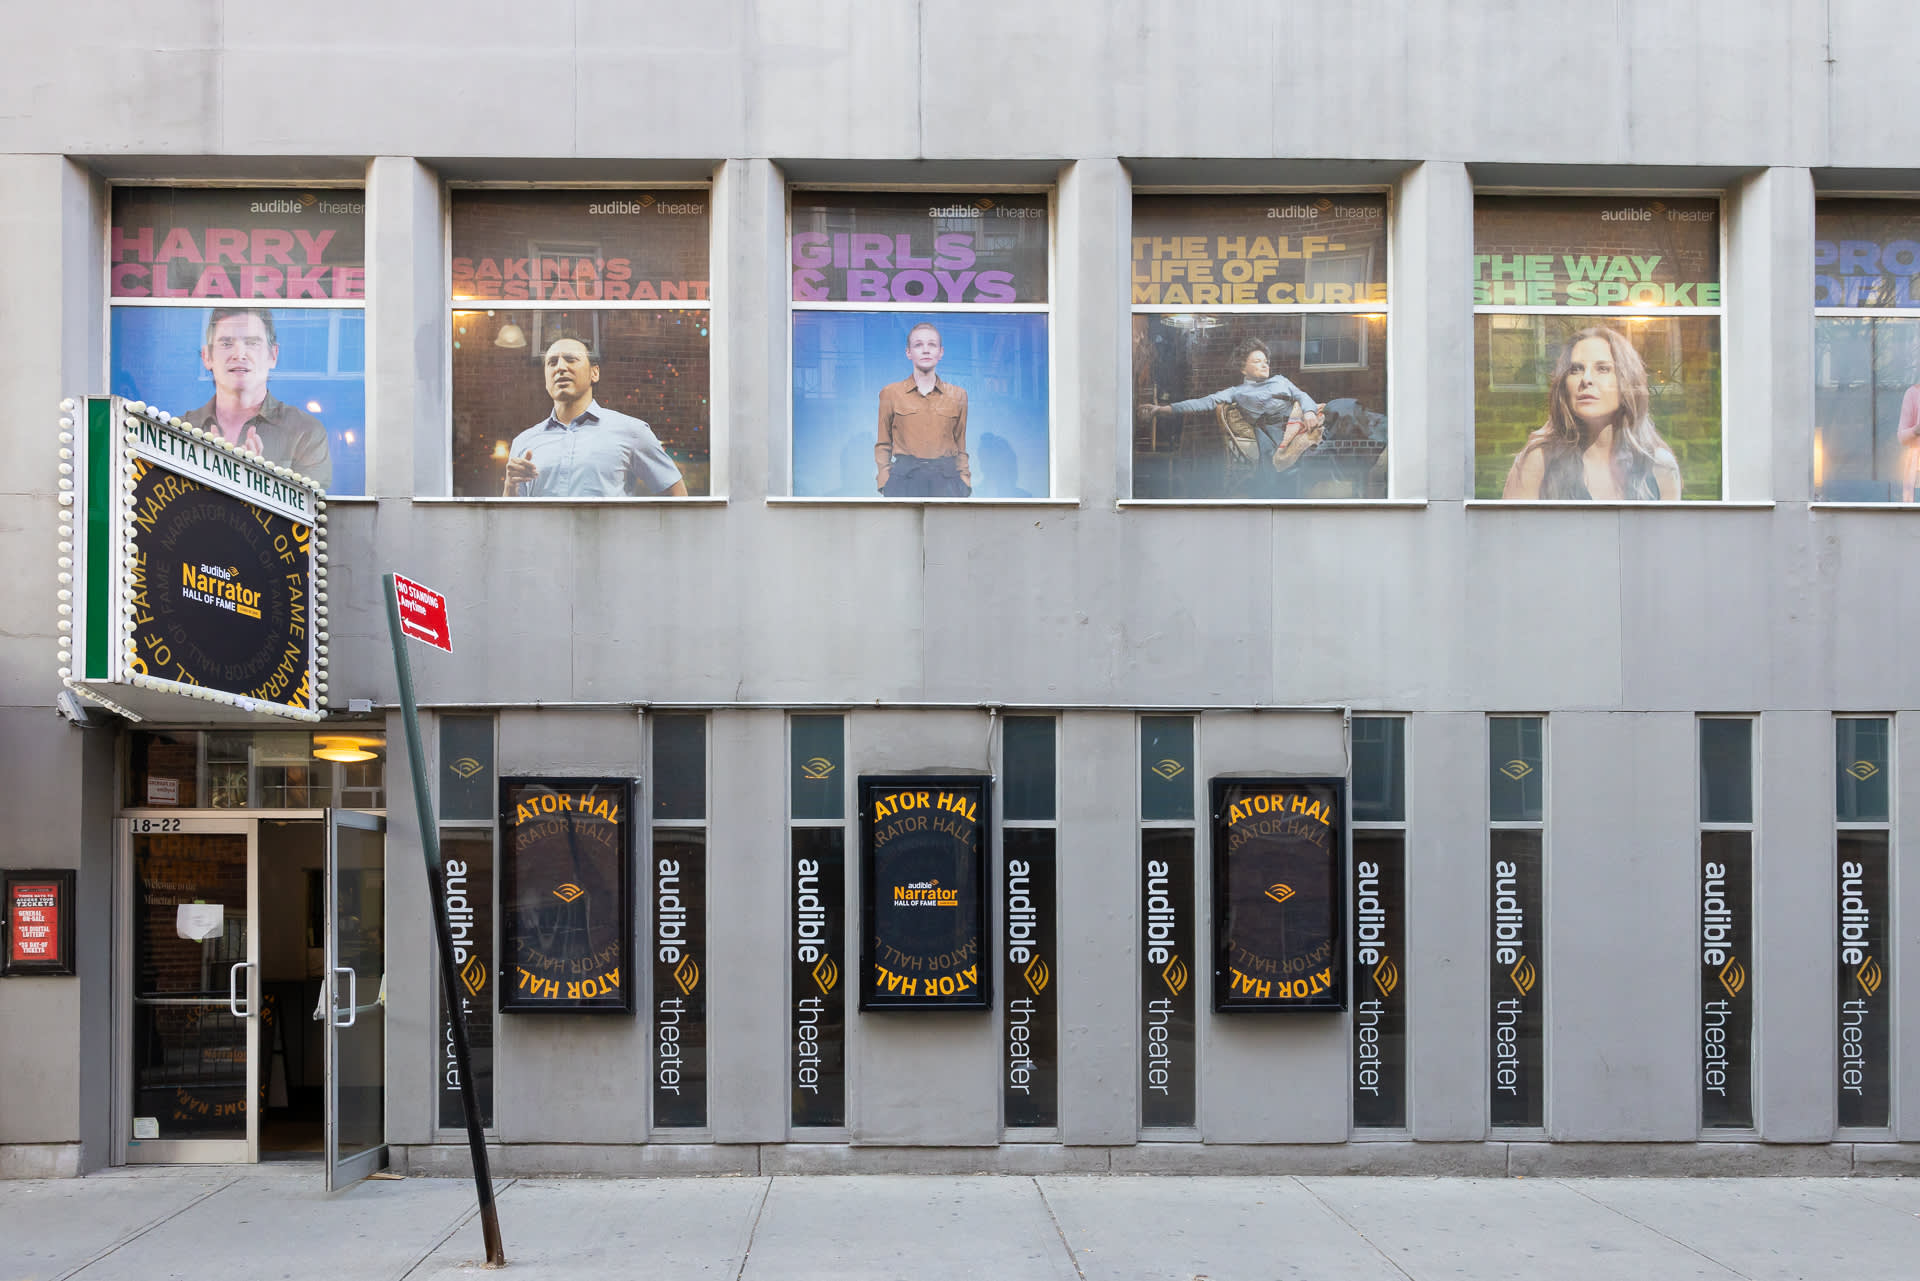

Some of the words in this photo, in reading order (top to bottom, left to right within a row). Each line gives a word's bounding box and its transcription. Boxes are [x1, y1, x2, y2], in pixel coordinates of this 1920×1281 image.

[250, 200, 303, 214] audible
[589, 201, 640, 215] audible
[657, 202, 705, 215] theater
[928, 205, 980, 218] audible
[996, 206, 1042, 218] theater
[1267, 205, 1318, 218] audible
[1335, 206, 1381, 218] theater
[1601, 208, 1652, 221] audible
[1668, 209, 1715, 222] theater
[111, 227, 336, 264] HARRY
[792, 231, 977, 271] GIRLS
[1132, 236, 1209, 259] THE
[1217, 236, 1346, 259] HALF-
[111, 263, 365, 299] CLARKE
[452, 257, 632, 280] SAKINA'S
[792, 269, 830, 302] &
[847, 270, 1017, 303] BOYS
[1132, 260, 1214, 283] LIFE
[1222, 259, 1280, 283] OF
[1473, 255, 1554, 281] THE
[1562, 255, 1662, 281] WAY
[1132, 282, 1258, 304] MARIE
[1267, 282, 1387, 304] CURIE
[1473, 281, 1557, 305] SHE
[1565, 282, 1720, 306] SPOKE
[129, 421, 198, 466] INETTA
[203, 449, 240, 484] LANE
[244, 467, 305, 511] THEATRE
[182, 562, 261, 608] Narrator
[200, 563, 231, 581] audible
[182, 587, 203, 602] HALL
[203, 594, 215, 605] OF
[215, 597, 236, 612] FAME
[286, 573, 306, 640] FAME
[398, 581, 408, 594] NO
[408, 586, 439, 608] STANDING
[133, 818, 181, 832] 18-22
[894, 886, 958, 900] Narrator
[907, 881, 932, 889] audible
[659, 859, 686, 964] audible
[798, 858, 825, 963] audible
[1009, 859, 1036, 964] audible
[1147, 860, 1175, 965] audible
[1358, 861, 1385, 965] audible
[1495, 861, 1523, 965] audible
[1703, 862, 1731, 966] audible
[1841, 861, 1869, 965] audible
[659, 997, 686, 1095] theater
[798, 996, 825, 1095] theater
[1010, 997, 1036, 1095] theater
[1148, 998, 1175, 1096] theater
[1359, 999, 1385, 1097] theater
[1496, 998, 1522, 1096] theater
[1704, 999, 1731, 1097] theater
[1842, 998, 1868, 1096] theater
